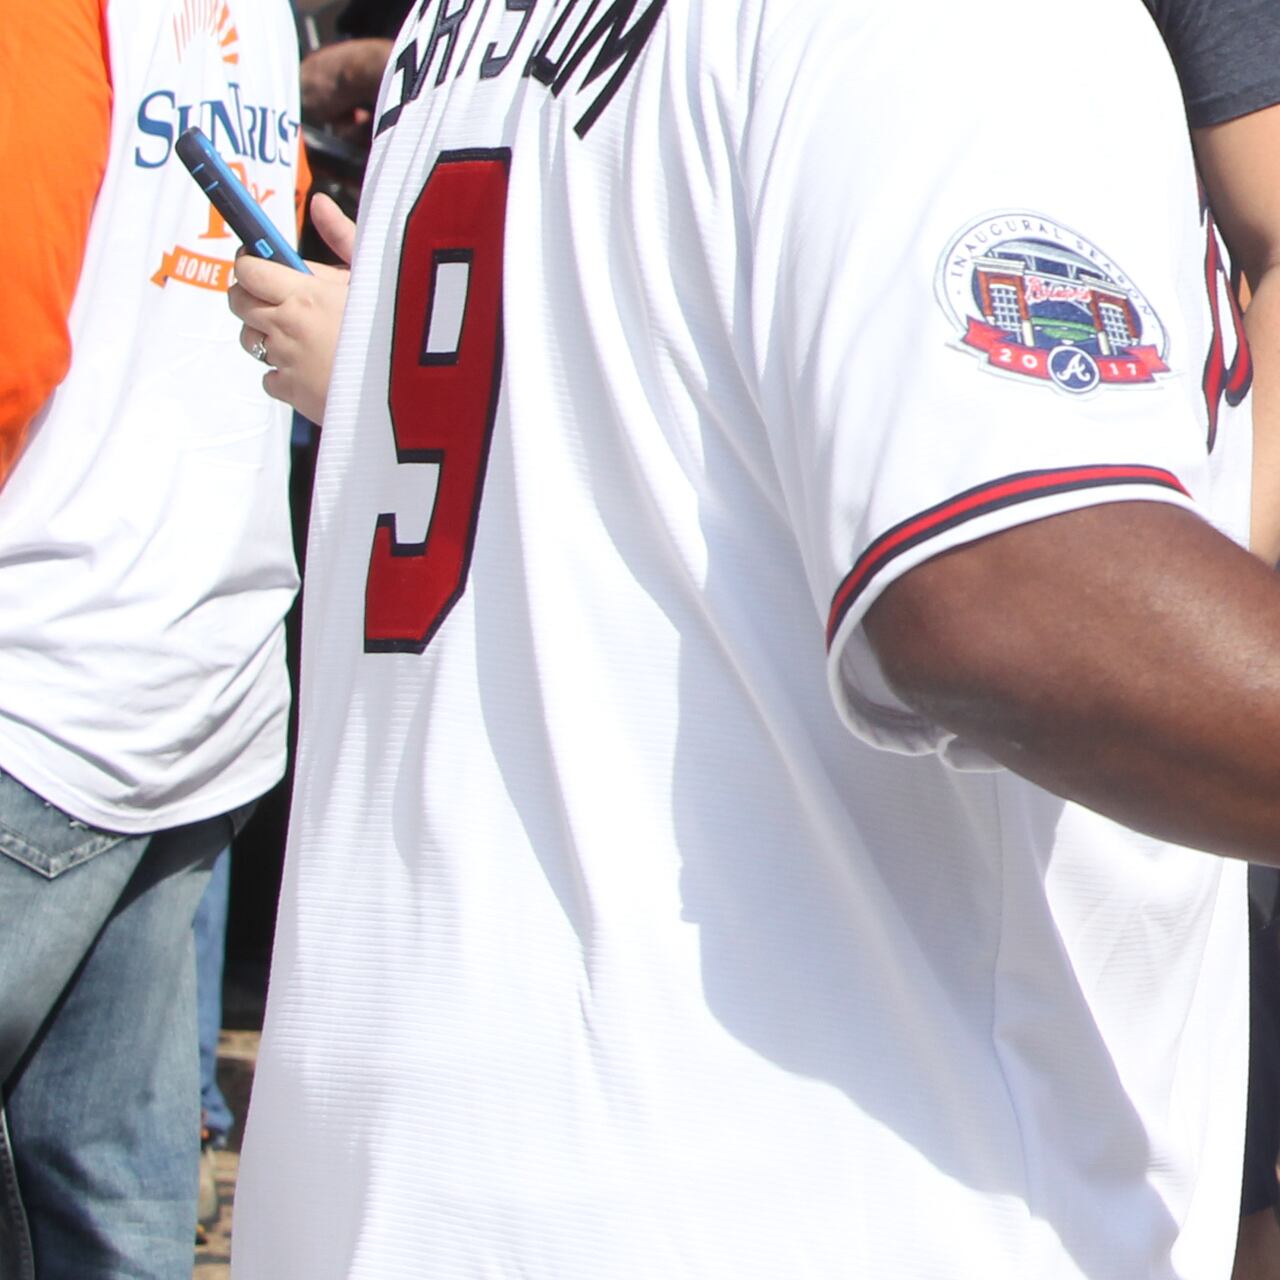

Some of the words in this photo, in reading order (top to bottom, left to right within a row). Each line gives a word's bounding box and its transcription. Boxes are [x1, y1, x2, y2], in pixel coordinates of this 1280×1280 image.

[175, 254, 223, 286] HOME
[950, 219, 1064, 279] INAUGURAL
[364, 146, 513, 654] 9
